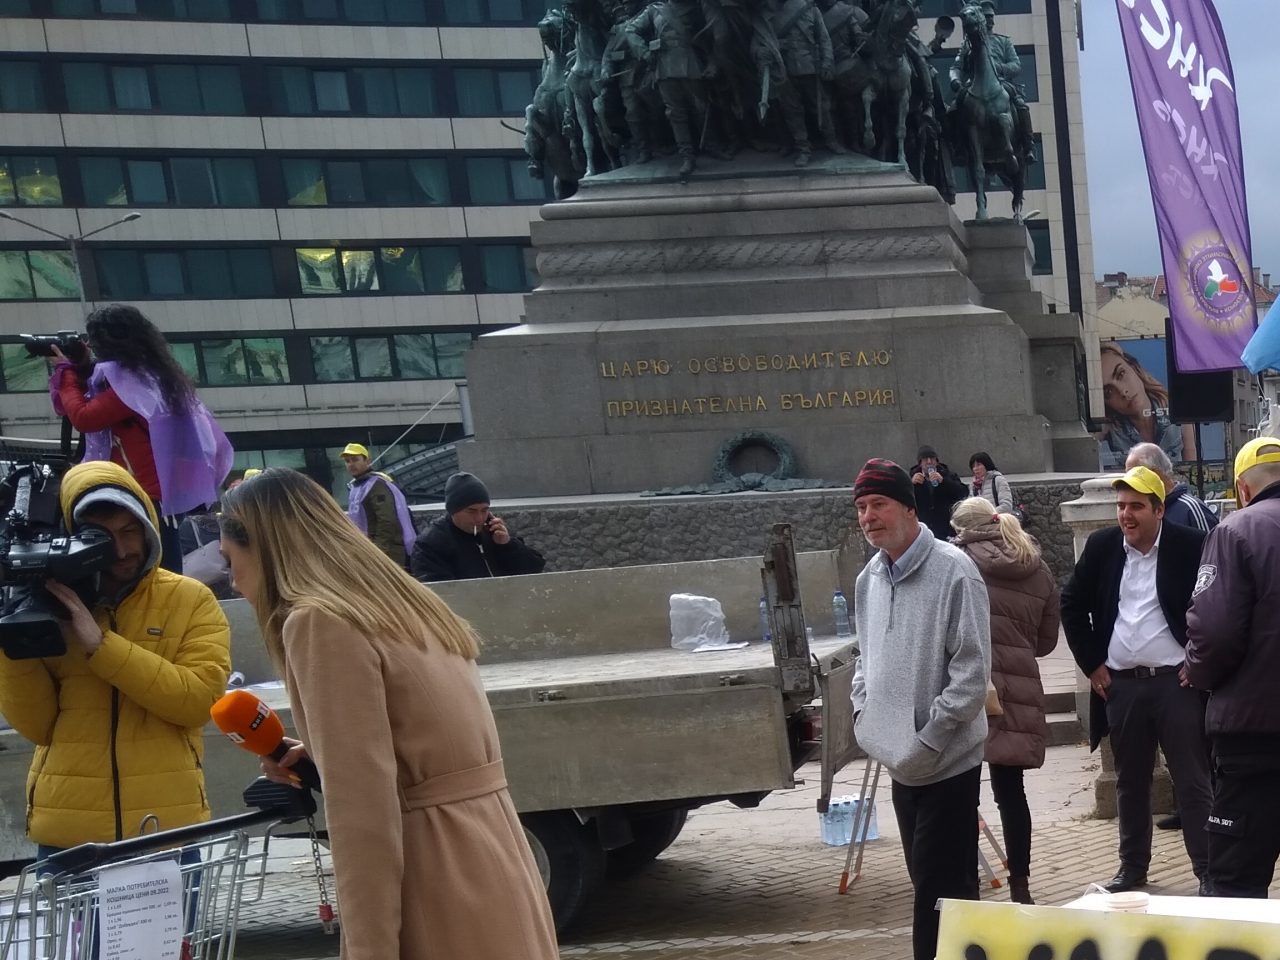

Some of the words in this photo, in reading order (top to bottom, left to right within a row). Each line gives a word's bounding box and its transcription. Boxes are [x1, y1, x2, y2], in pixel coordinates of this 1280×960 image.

[601, 359, 670, 378] ЦАРЮ
[688, 350, 890, 374] ОСВОБОДИТЕЛЮ
[607, 395, 768, 417] ПРИЗНАТЕЛНА
[780, 389, 896, 411] БЪЛГАРИЯ
